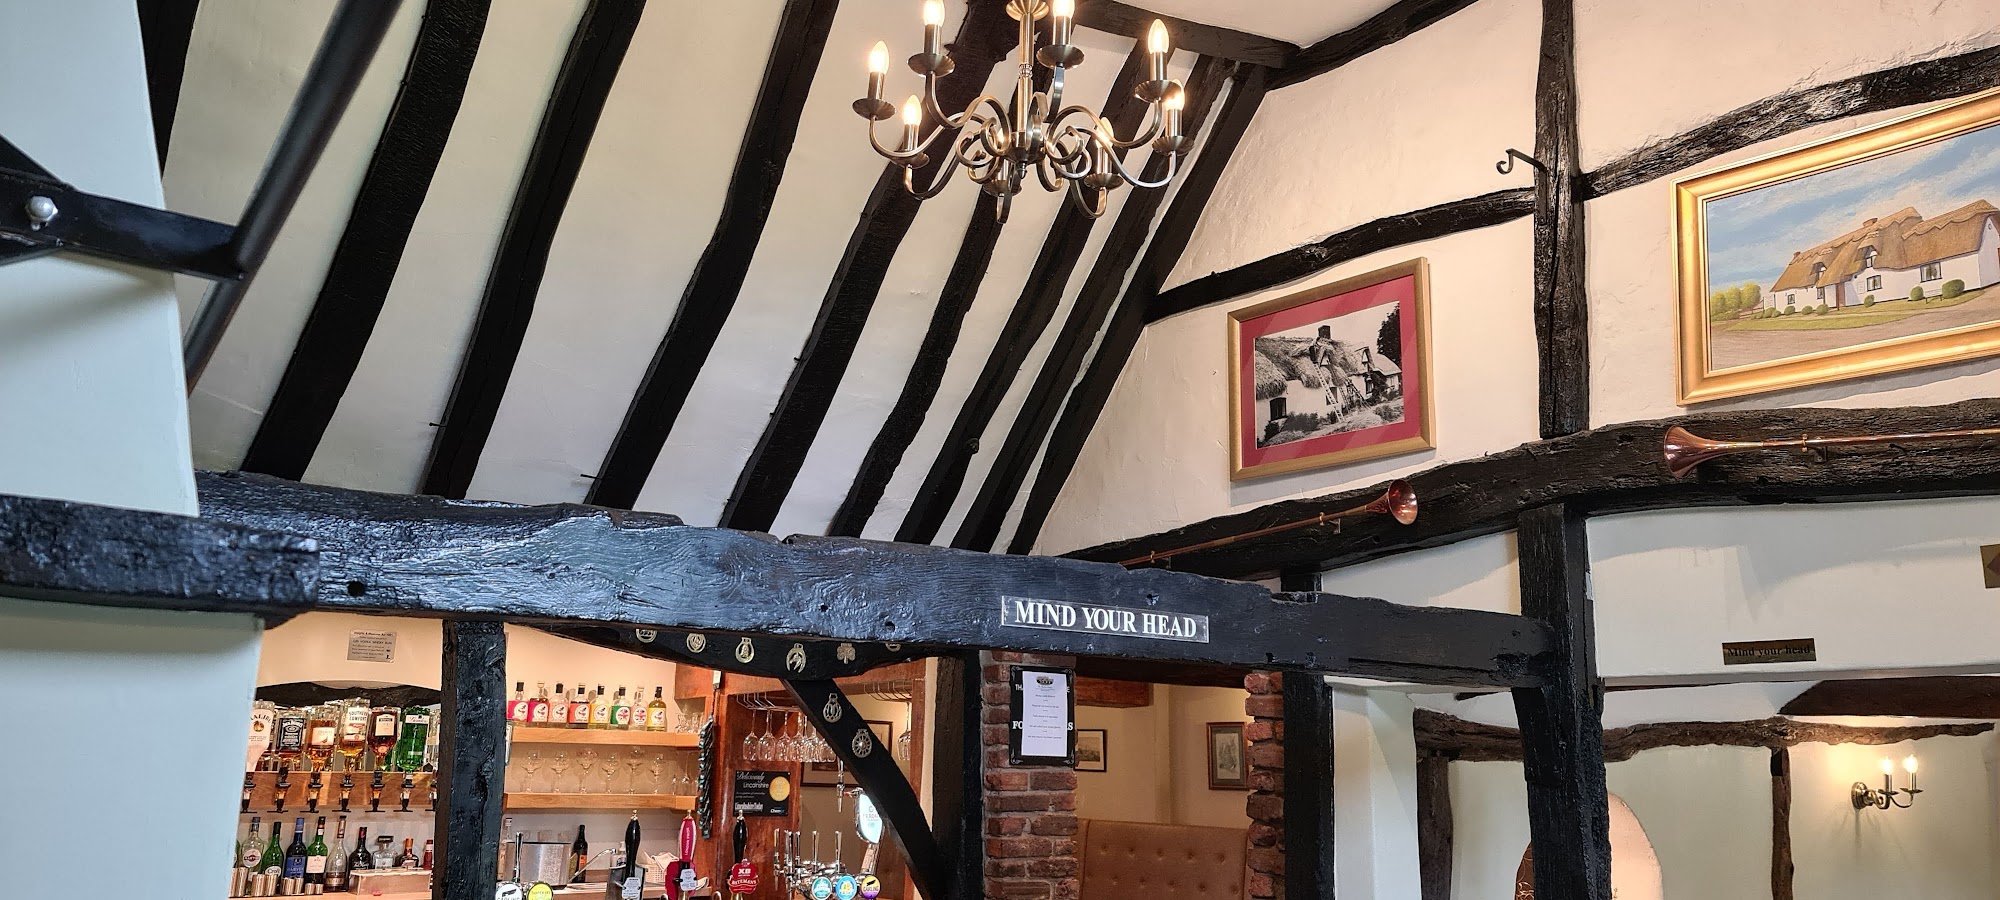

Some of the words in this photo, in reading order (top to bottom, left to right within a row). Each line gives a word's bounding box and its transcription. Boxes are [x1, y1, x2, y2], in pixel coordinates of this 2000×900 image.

[1014, 600, 1077, 627] MIND
[1082, 607, 1137, 632] YOUR
[1142, 613, 1197, 638] HEAD
[1727, 647, 1754, 657] Mind
[1758, 647, 1782, 658] your
[1785, 644, 1810, 654] head
